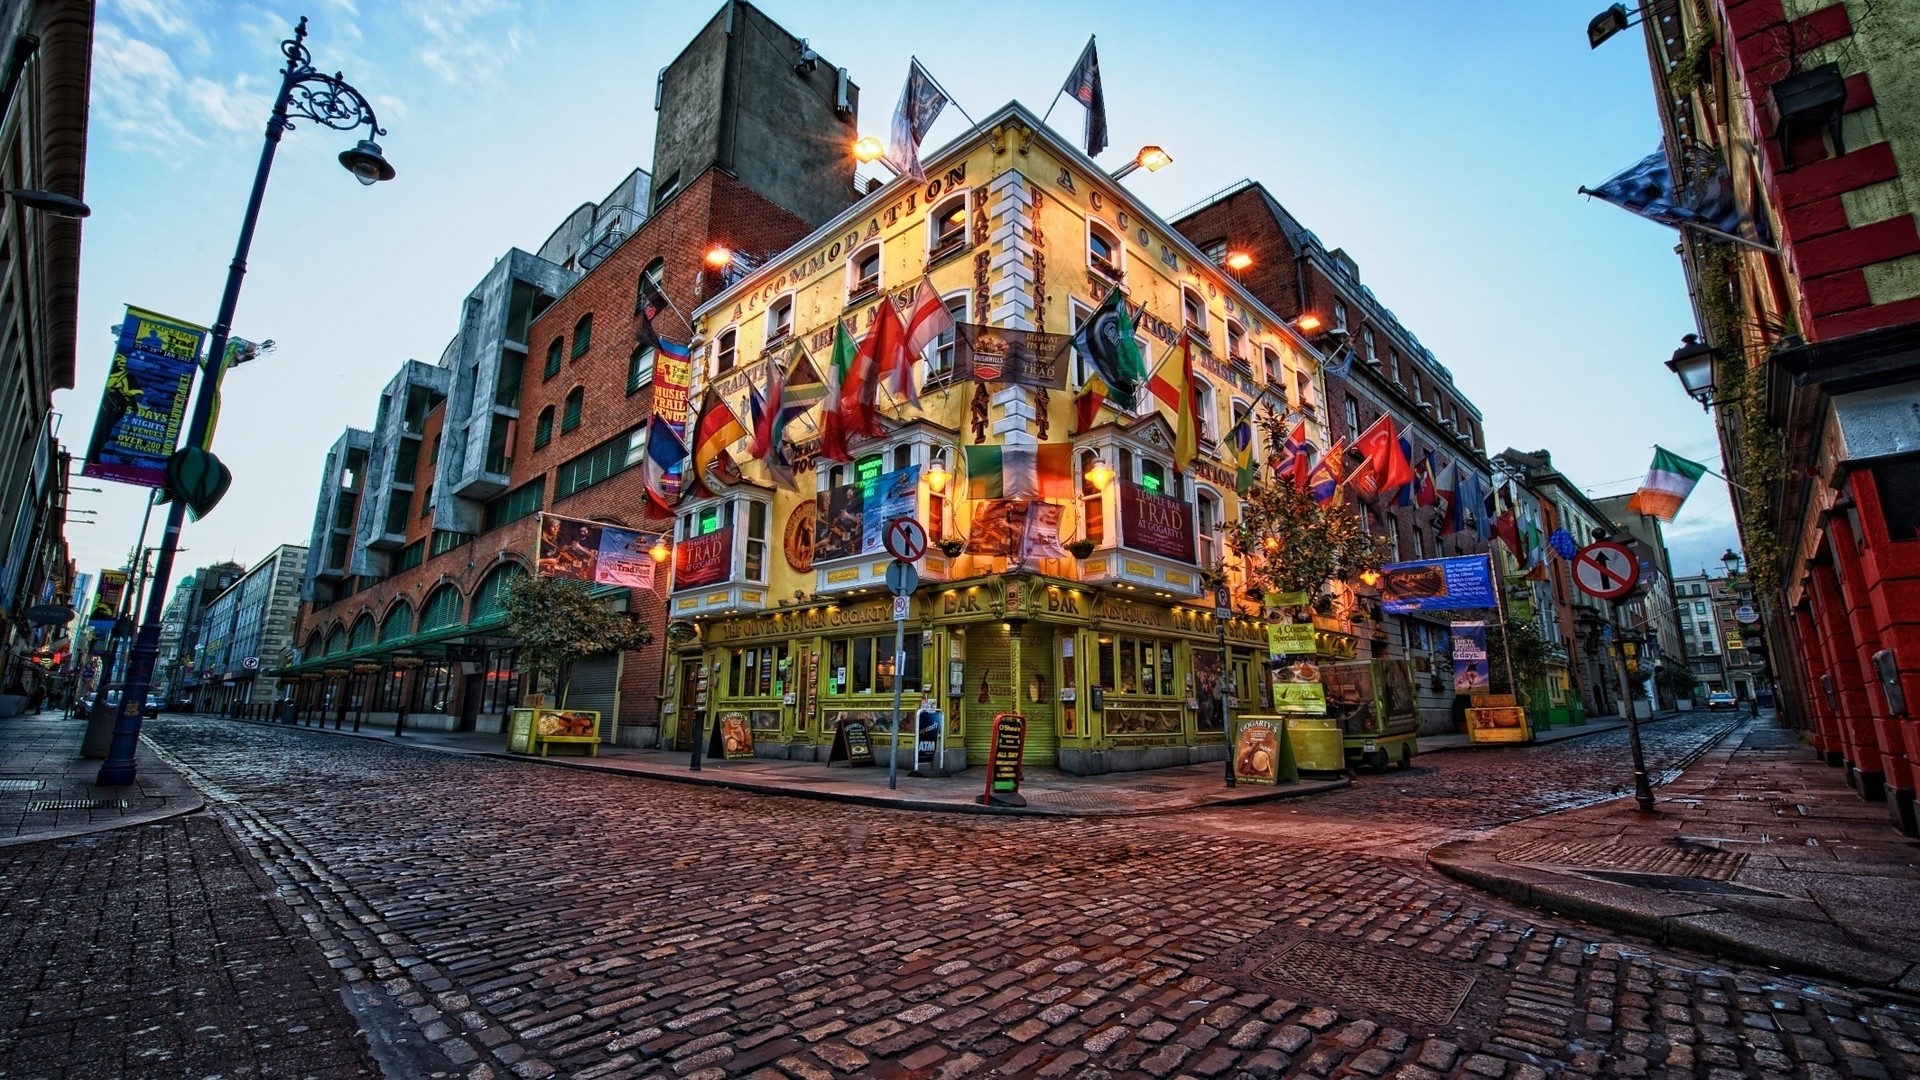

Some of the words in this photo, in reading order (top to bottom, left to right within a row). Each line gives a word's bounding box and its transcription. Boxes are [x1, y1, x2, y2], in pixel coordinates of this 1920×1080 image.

[973, 187, 990, 249] BAR
[1030, 186, 1045, 248] BAR
[730, 160, 968, 323] ACCOMMODATION
[168, 334, 195, 348] Trad
[1026, 333, 1047, 343] IRISH
[1026, 341, 1038, 349] ITS
[1040, 343, 1057, 351] BEST
[973, 354, 1004, 364] BUSHMILLS
[1023, 364, 1055, 377] TRAD
[654, 384, 686, 400] MUSIC
[653, 396, 686, 411] TRAIL
[136, 408, 168, 422] DAYS
[653, 405, 688, 423] VENUE
[131, 417, 166, 432] NIGHTS
[117, 433, 143, 445] OVER
[144, 441, 161, 450] 200
[1137, 489, 1165, 507] TEMPLE
[1167, 496, 1182, 512] BAR
[1136, 497, 1183, 530] TRAD
[1147, 521, 1184, 540] GOGARTY'S
[687, 537, 712, 548] TEMPLE
[686, 540, 722, 564] TRAD
[692, 557, 721, 571] GOGARTY'S
[944, 591, 981, 615] BAR
[1047, 590, 1080, 615] BAR
[724, 622, 742, 640] THE
[743, 616, 779, 637] OLIVER
[830, 603, 893, 627] GOGARTY
[1101, 600, 1162, 627] RESTAURANT
[1194, 615, 1228, 637] OLIVR
[1277, 626, 1283, 635] 4
[1283, 624, 1309, 634] Course
[1273, 634, 1296, 644] Special
[1240, 720, 1278, 733] GOGARTY'S
[919, 740, 936, 752] ATM
